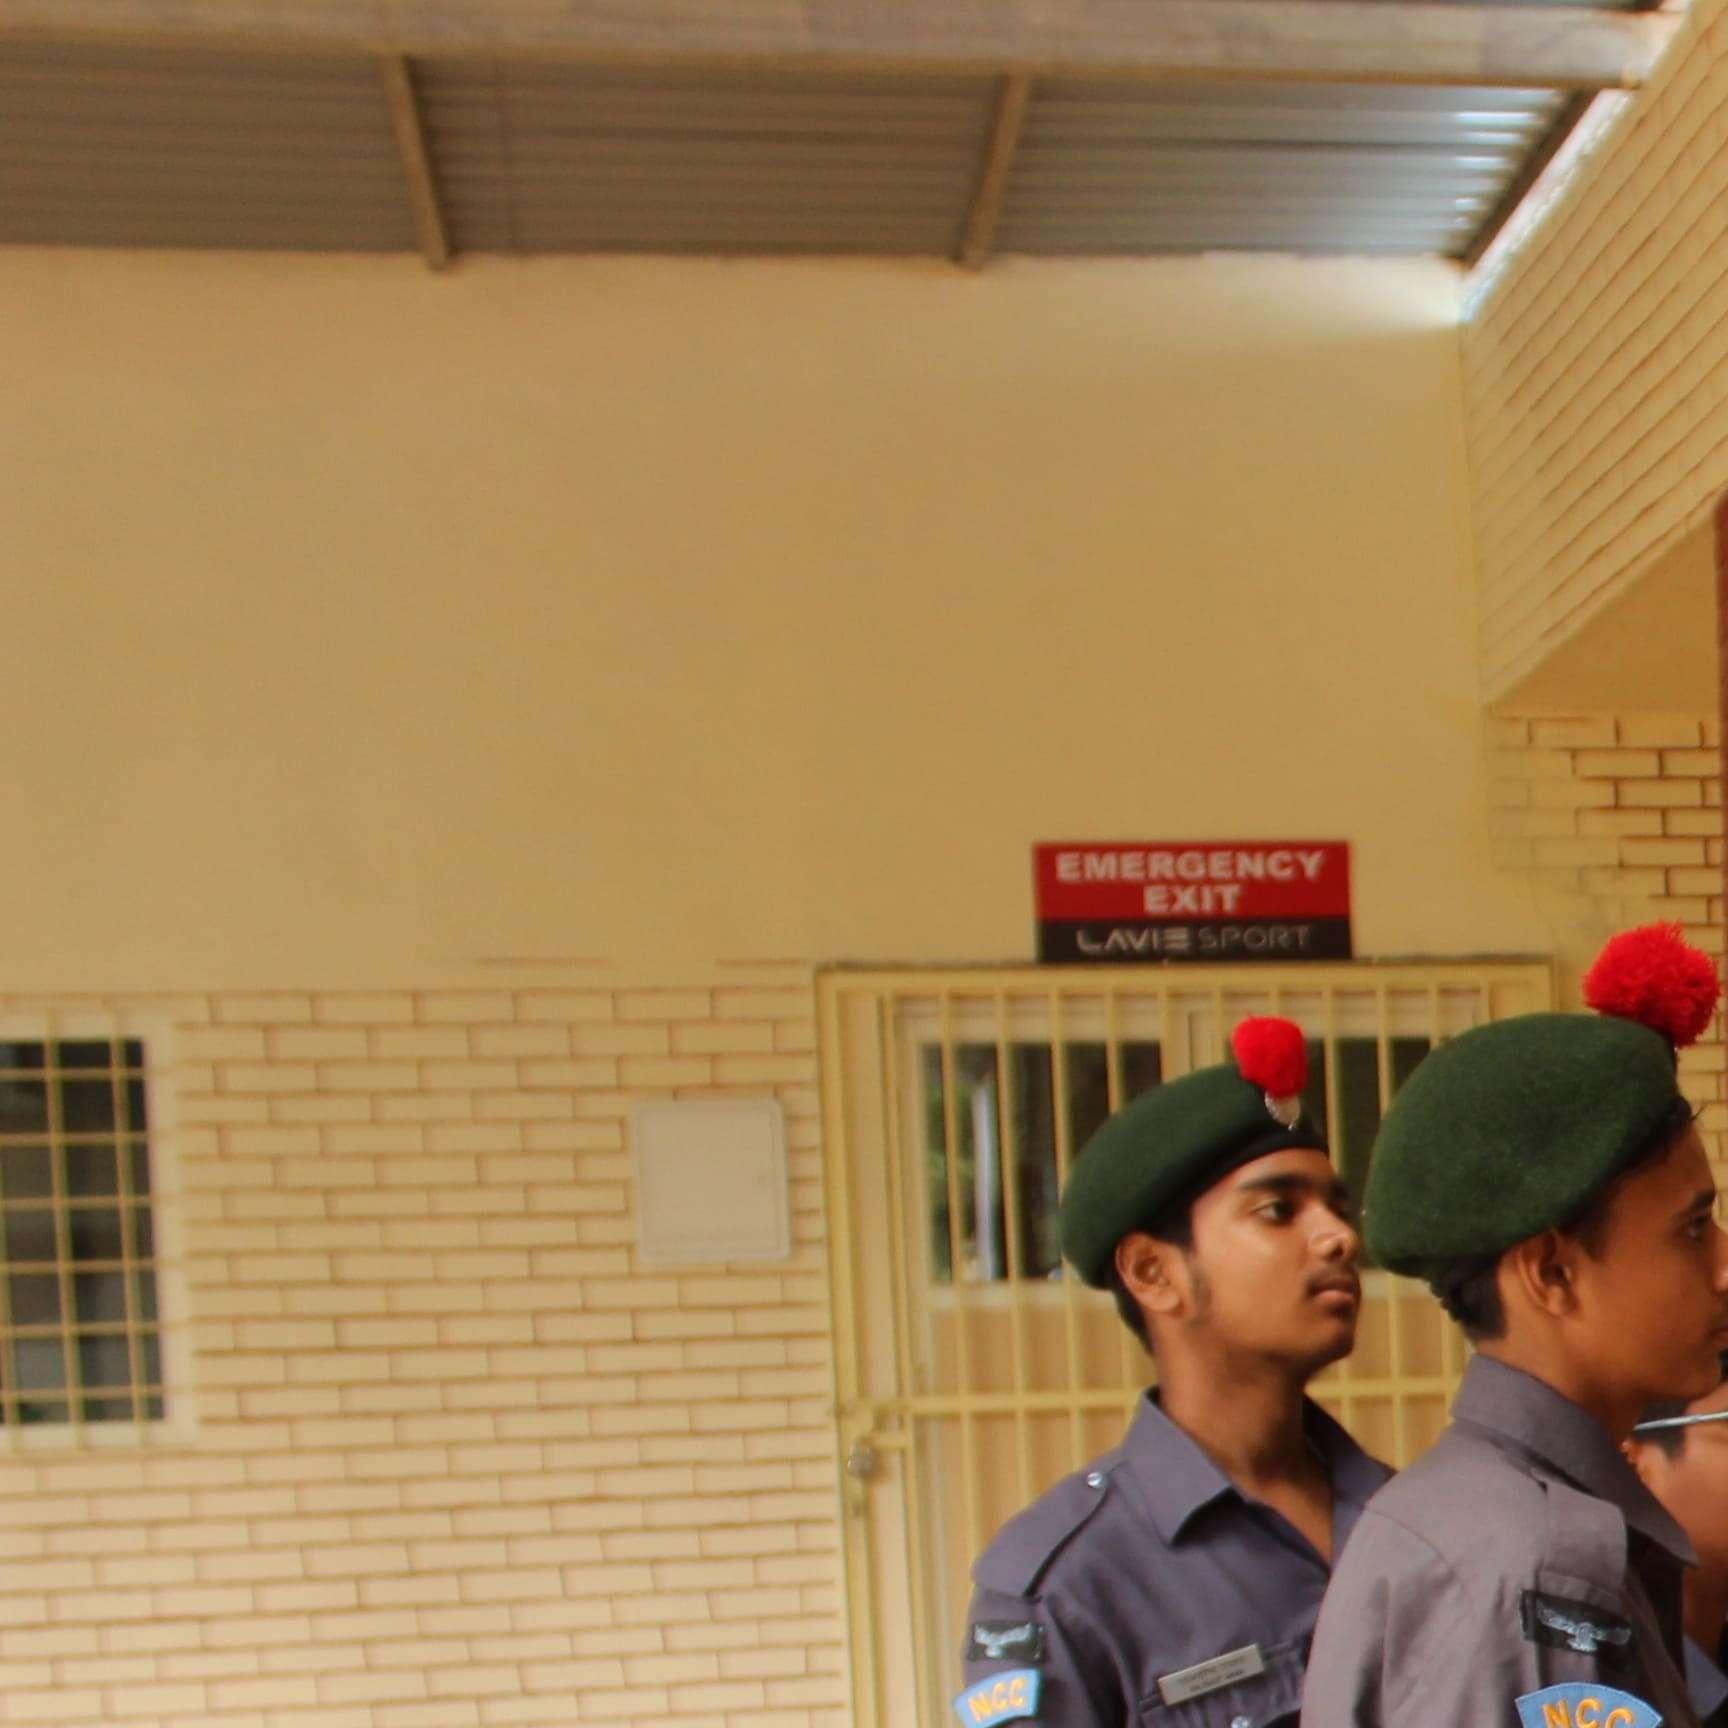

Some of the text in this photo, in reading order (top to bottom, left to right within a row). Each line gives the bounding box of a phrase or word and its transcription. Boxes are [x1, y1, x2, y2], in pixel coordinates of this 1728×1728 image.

[1055, 849, 1325, 882] EMERGENCY
[1143, 883, 1243, 914] EXIT
[1076, 925, 1313, 955] LAVIE SPORT
[967, 1677, 1025, 1723] NCC
